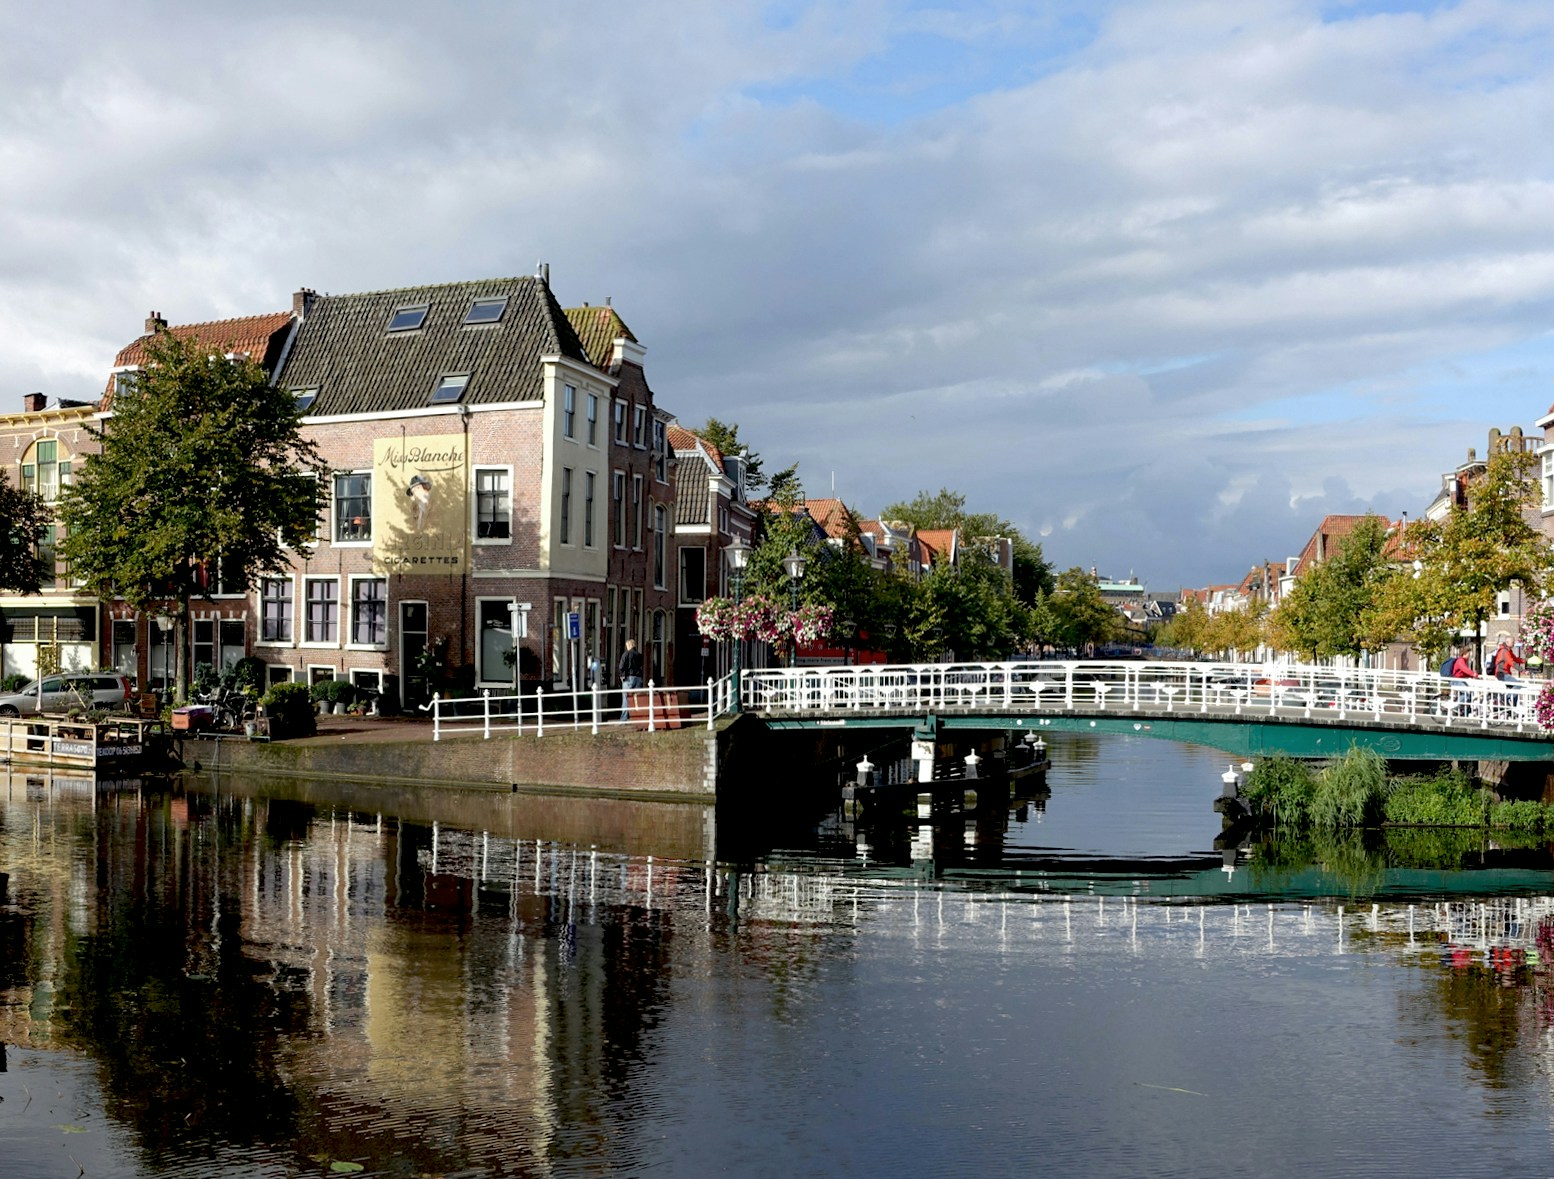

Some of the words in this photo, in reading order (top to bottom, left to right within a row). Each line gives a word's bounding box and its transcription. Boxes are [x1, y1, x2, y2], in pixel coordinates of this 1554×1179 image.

[378, 446, 410, 468] Miss
[408, 446, 464, 464] Blanche
[383, 556, 458, 565] CIGARETTES
